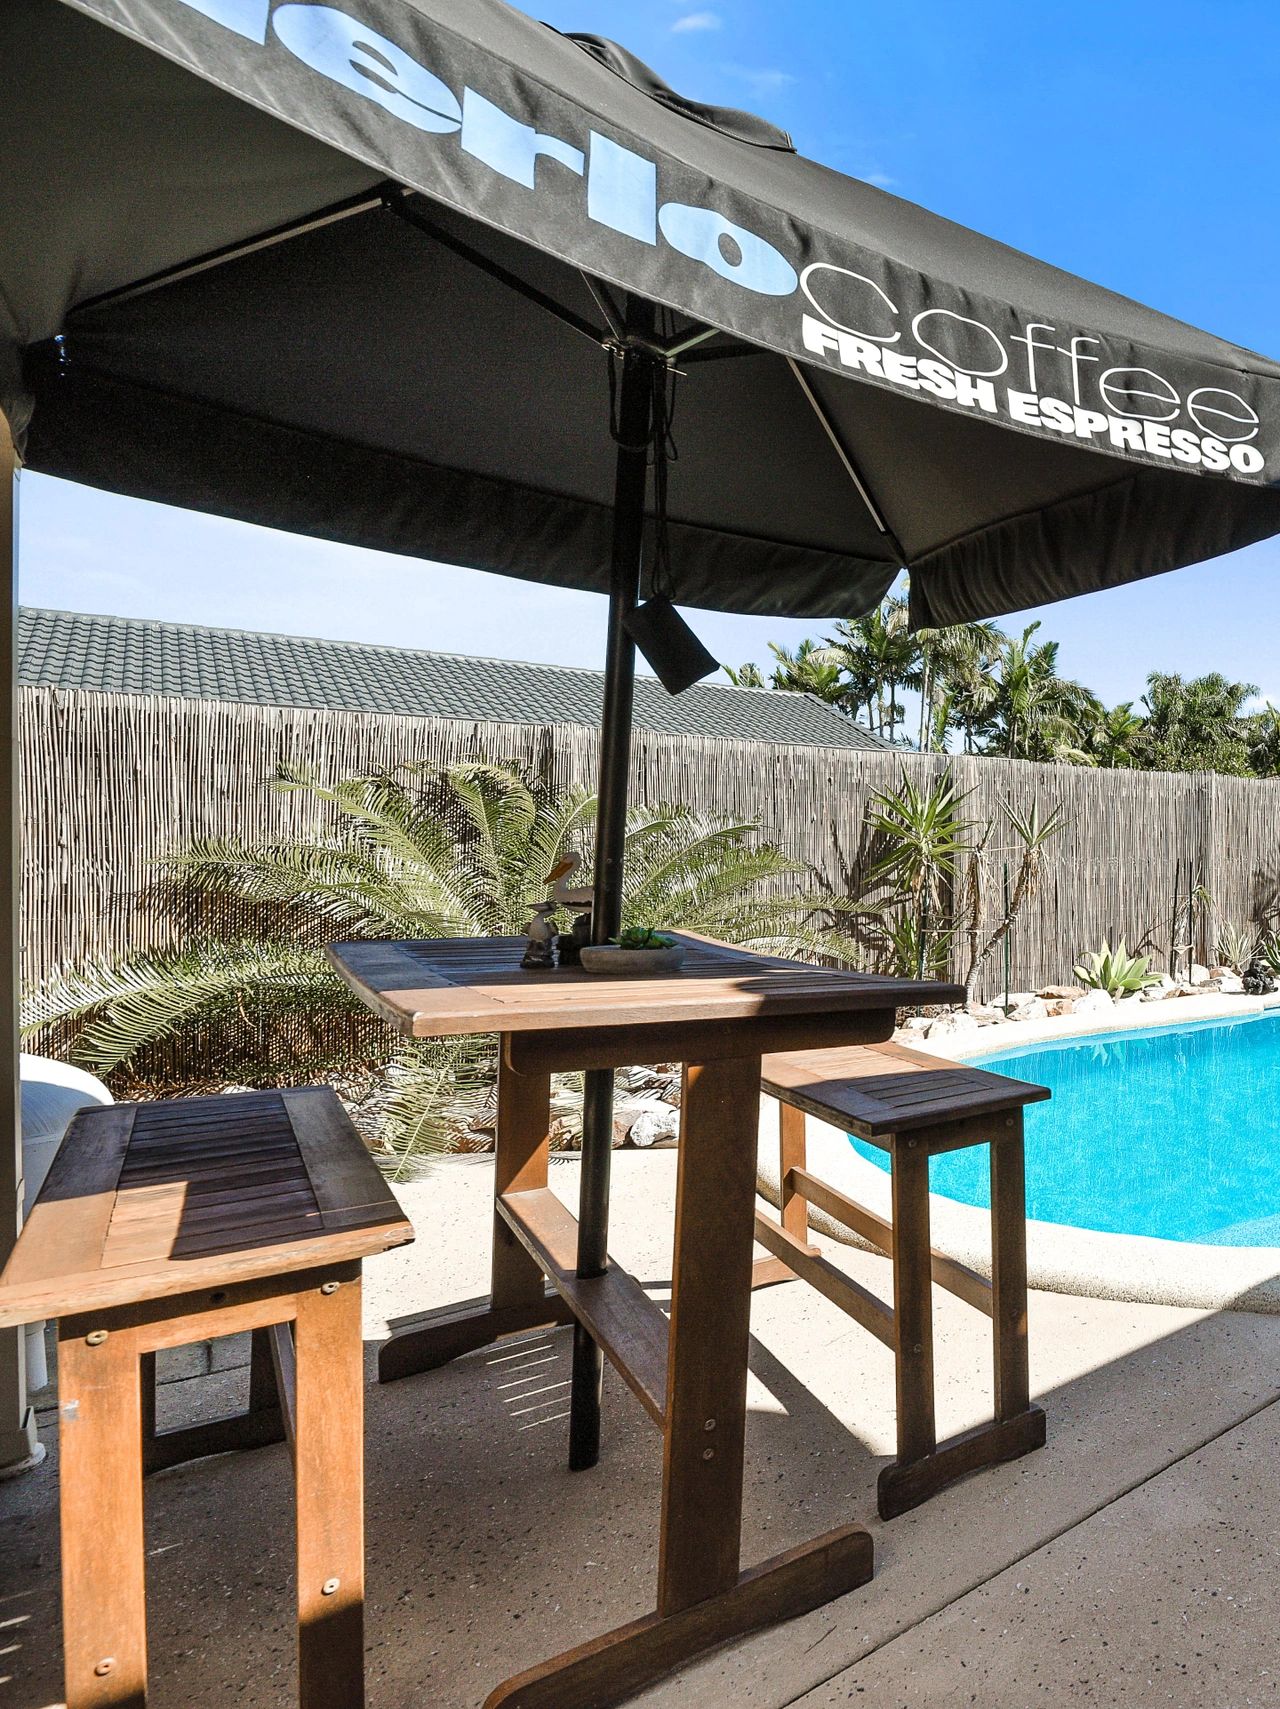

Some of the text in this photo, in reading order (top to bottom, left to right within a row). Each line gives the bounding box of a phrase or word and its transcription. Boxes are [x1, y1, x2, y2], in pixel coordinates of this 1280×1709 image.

[179, 0, 798, 296] erlo
[802, 314, 1265, 473] FRESH ESPRESSO
